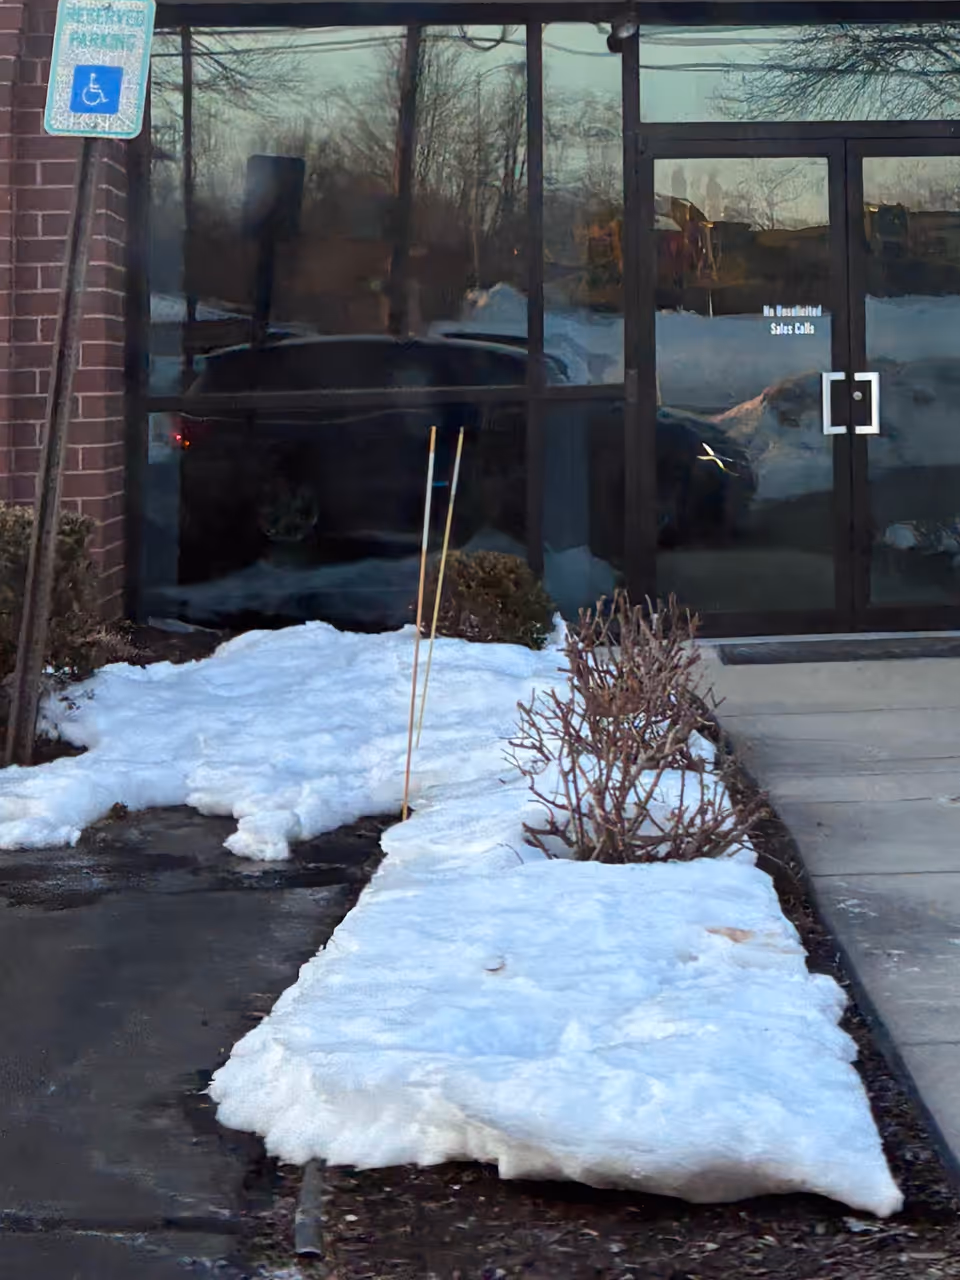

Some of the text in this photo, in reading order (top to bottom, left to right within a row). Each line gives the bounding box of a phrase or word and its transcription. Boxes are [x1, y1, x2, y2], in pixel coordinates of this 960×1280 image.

[763, 305, 774, 317] No
[770, 322, 815, 335] Sales Calls
